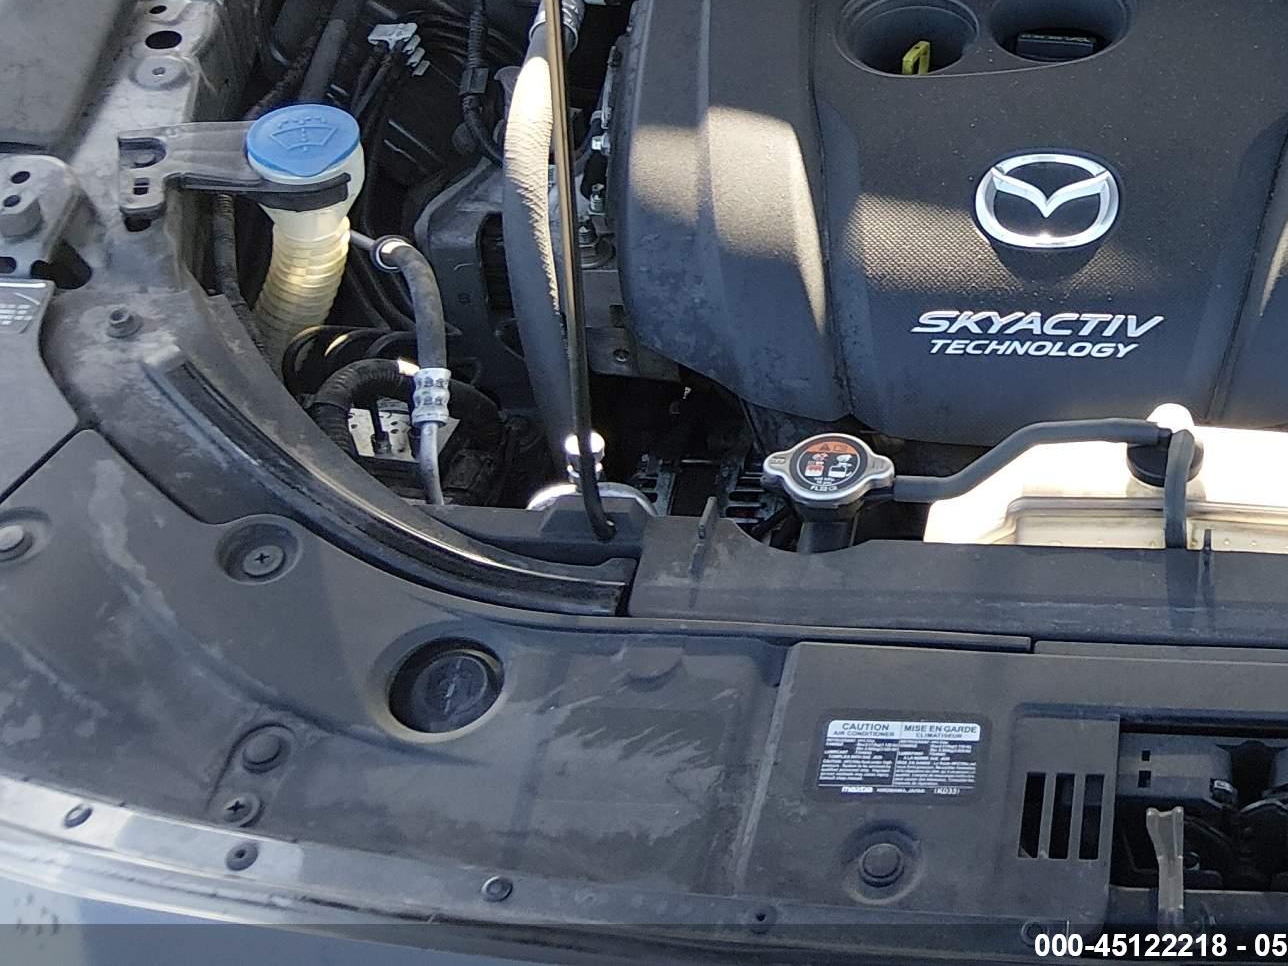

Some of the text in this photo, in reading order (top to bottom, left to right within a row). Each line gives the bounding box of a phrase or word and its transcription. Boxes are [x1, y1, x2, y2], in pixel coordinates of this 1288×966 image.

[911, 310, 1165, 338] SKYACTIV
[930, 339, 1140, 359] TECHNOLOGY
[842, 722, 890, 731] CAUTION
[904, 724, 926, 732] MISE
[943, 725, 977, 734] GARDE
